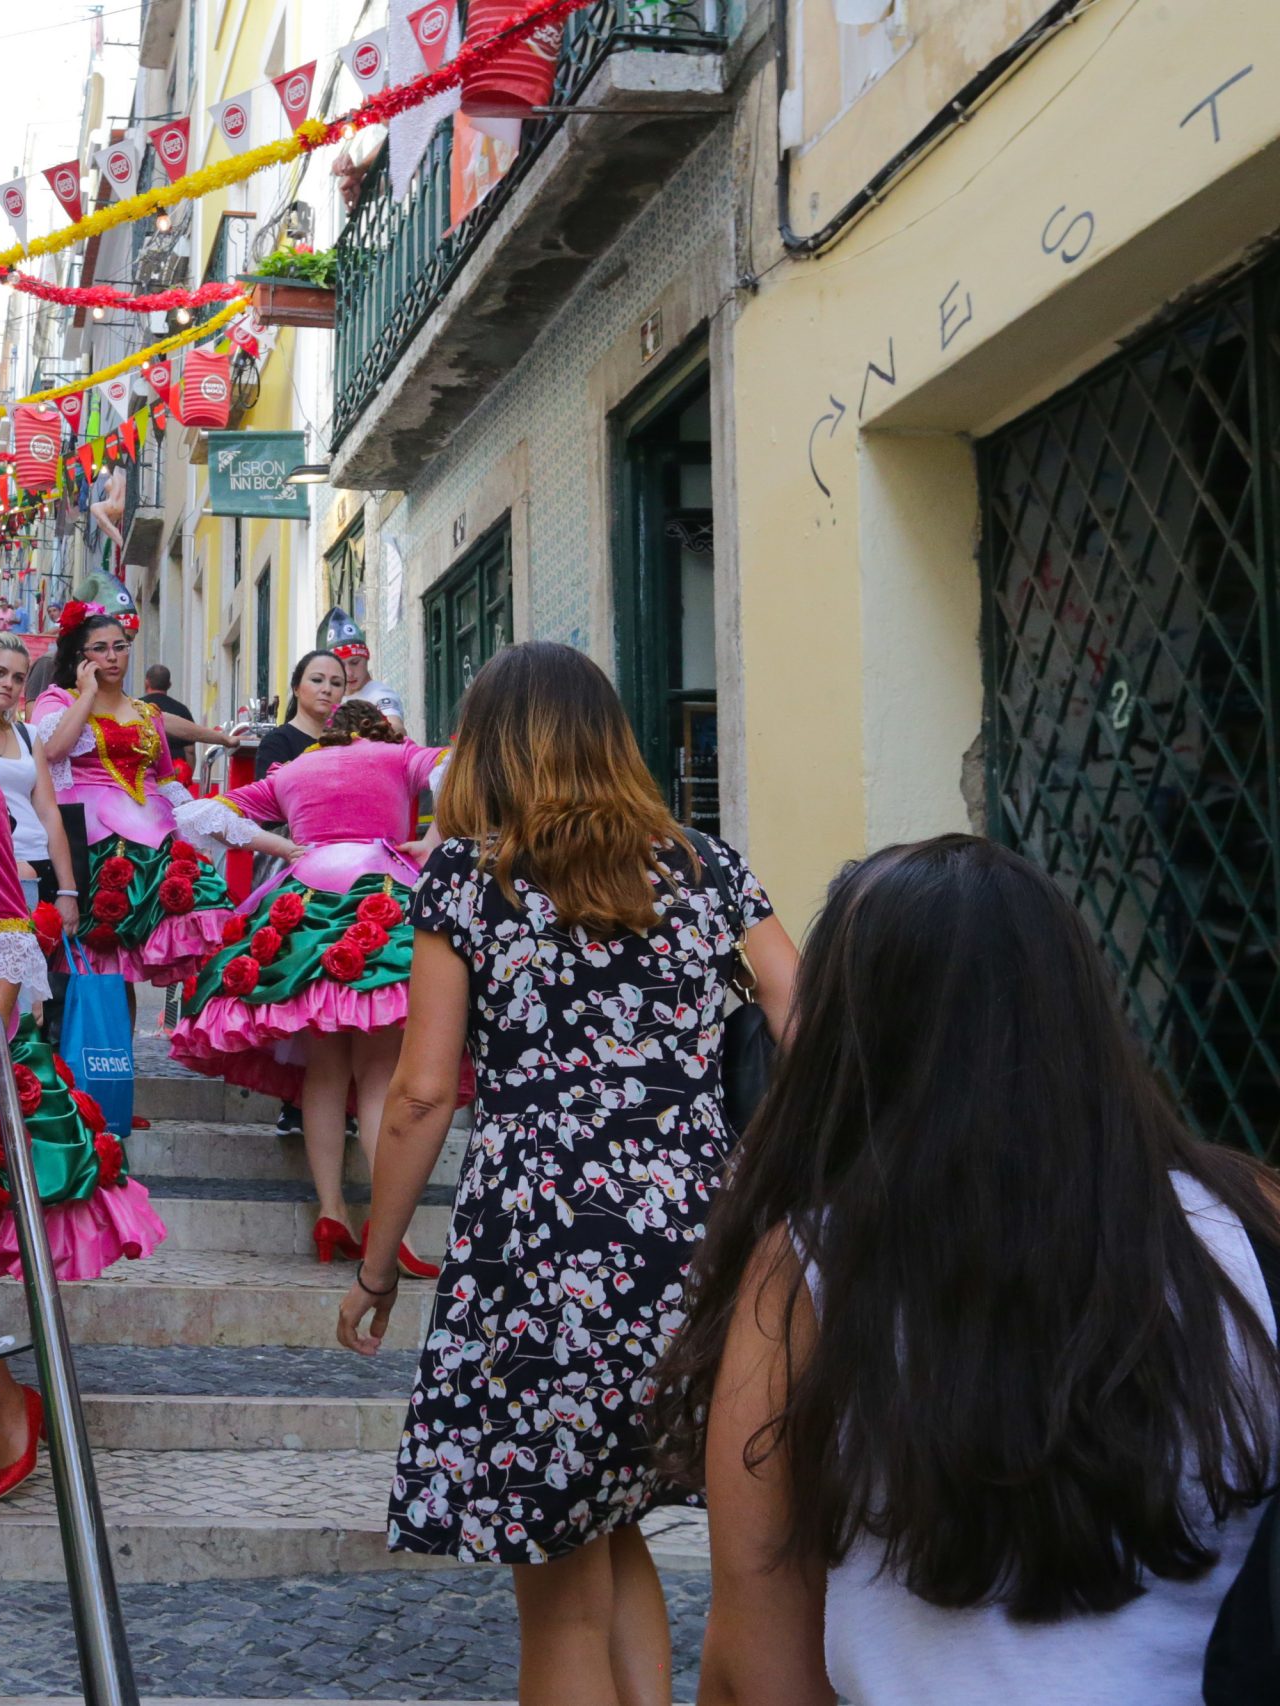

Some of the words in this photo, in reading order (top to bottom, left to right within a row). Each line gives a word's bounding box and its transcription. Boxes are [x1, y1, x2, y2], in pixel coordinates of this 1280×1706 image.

[230, 461, 286, 476] LISBON
[230, 477, 251, 490] INN
[254, 477, 285, 490] BICA
